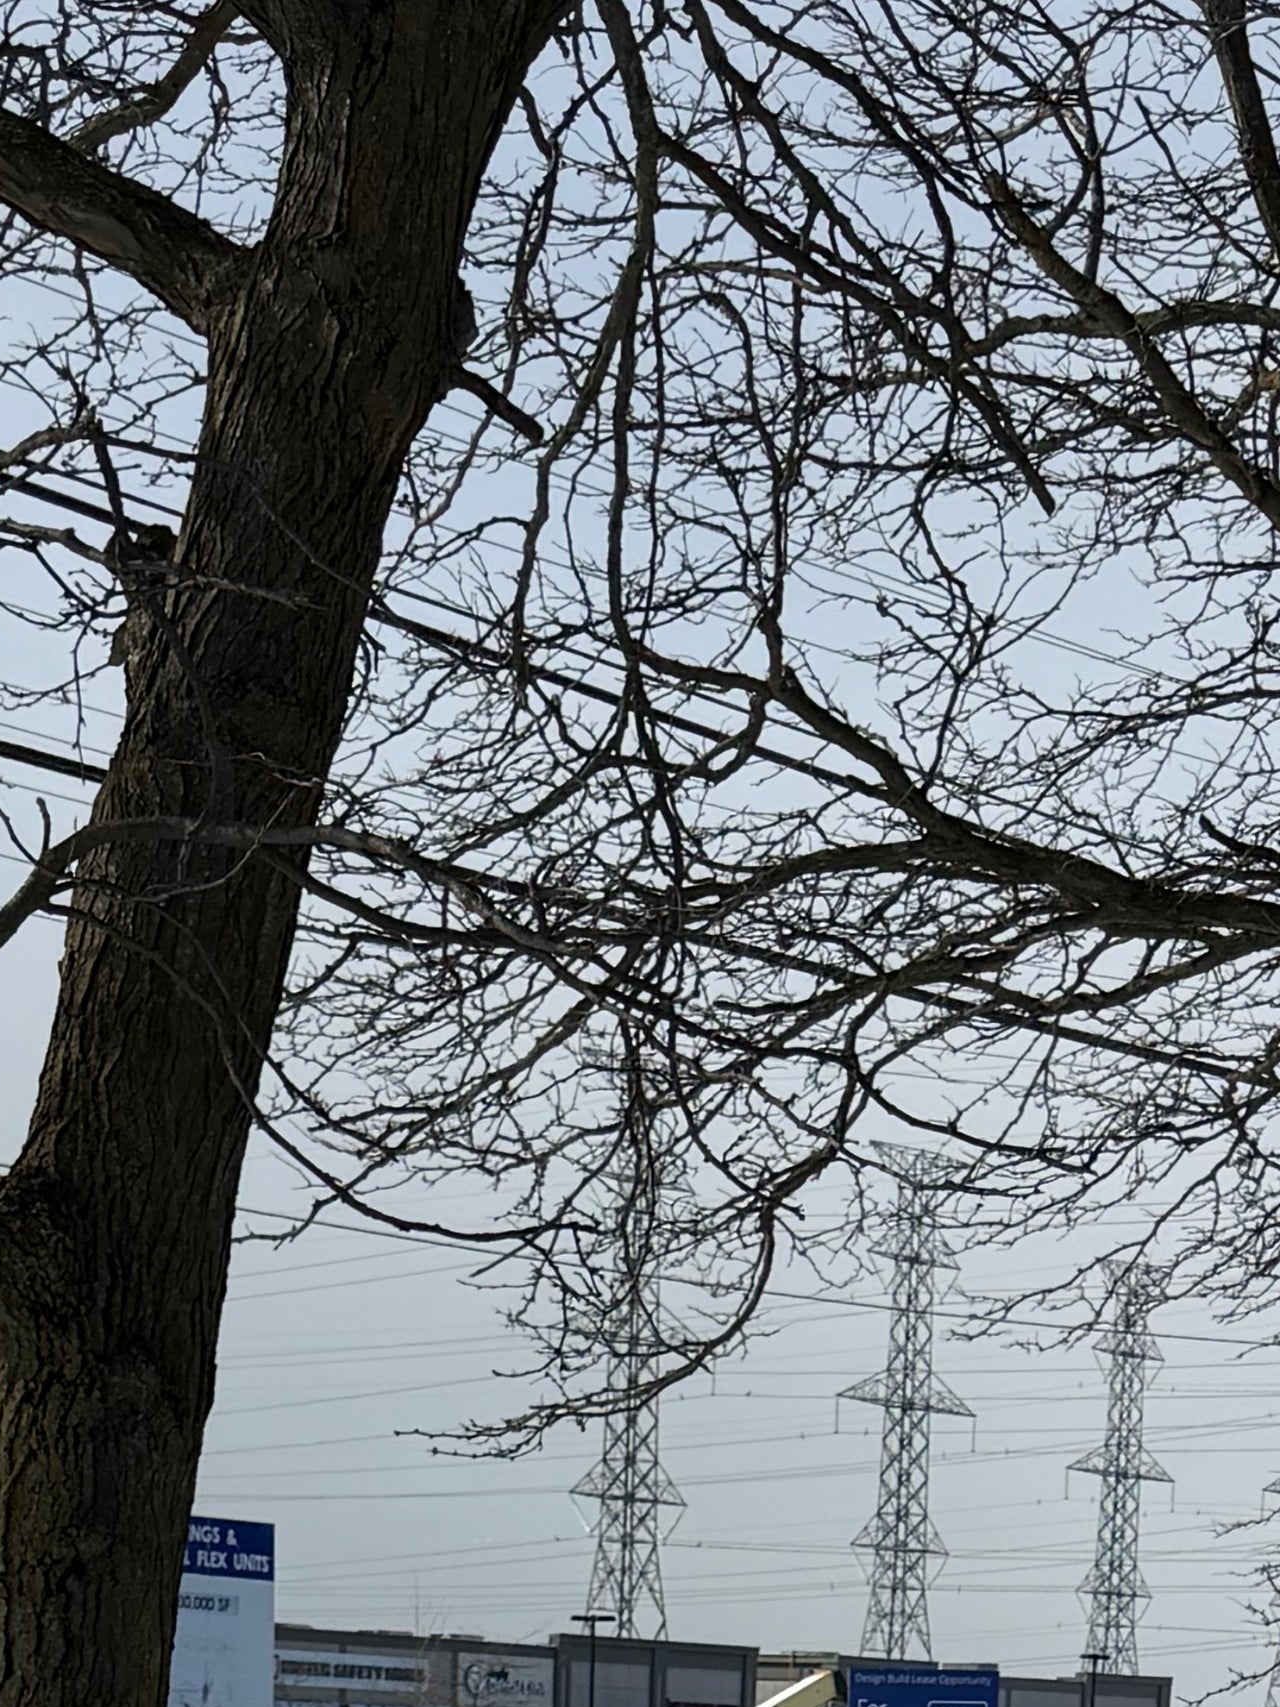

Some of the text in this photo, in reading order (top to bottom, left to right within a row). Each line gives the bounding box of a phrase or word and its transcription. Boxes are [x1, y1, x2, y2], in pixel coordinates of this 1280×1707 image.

[197, 1550, 227, 1569] FLEX
[233, 1553, 269, 1573] UNITS
[854, 1673, 993, 1687] Design Build Lease Opportunity
